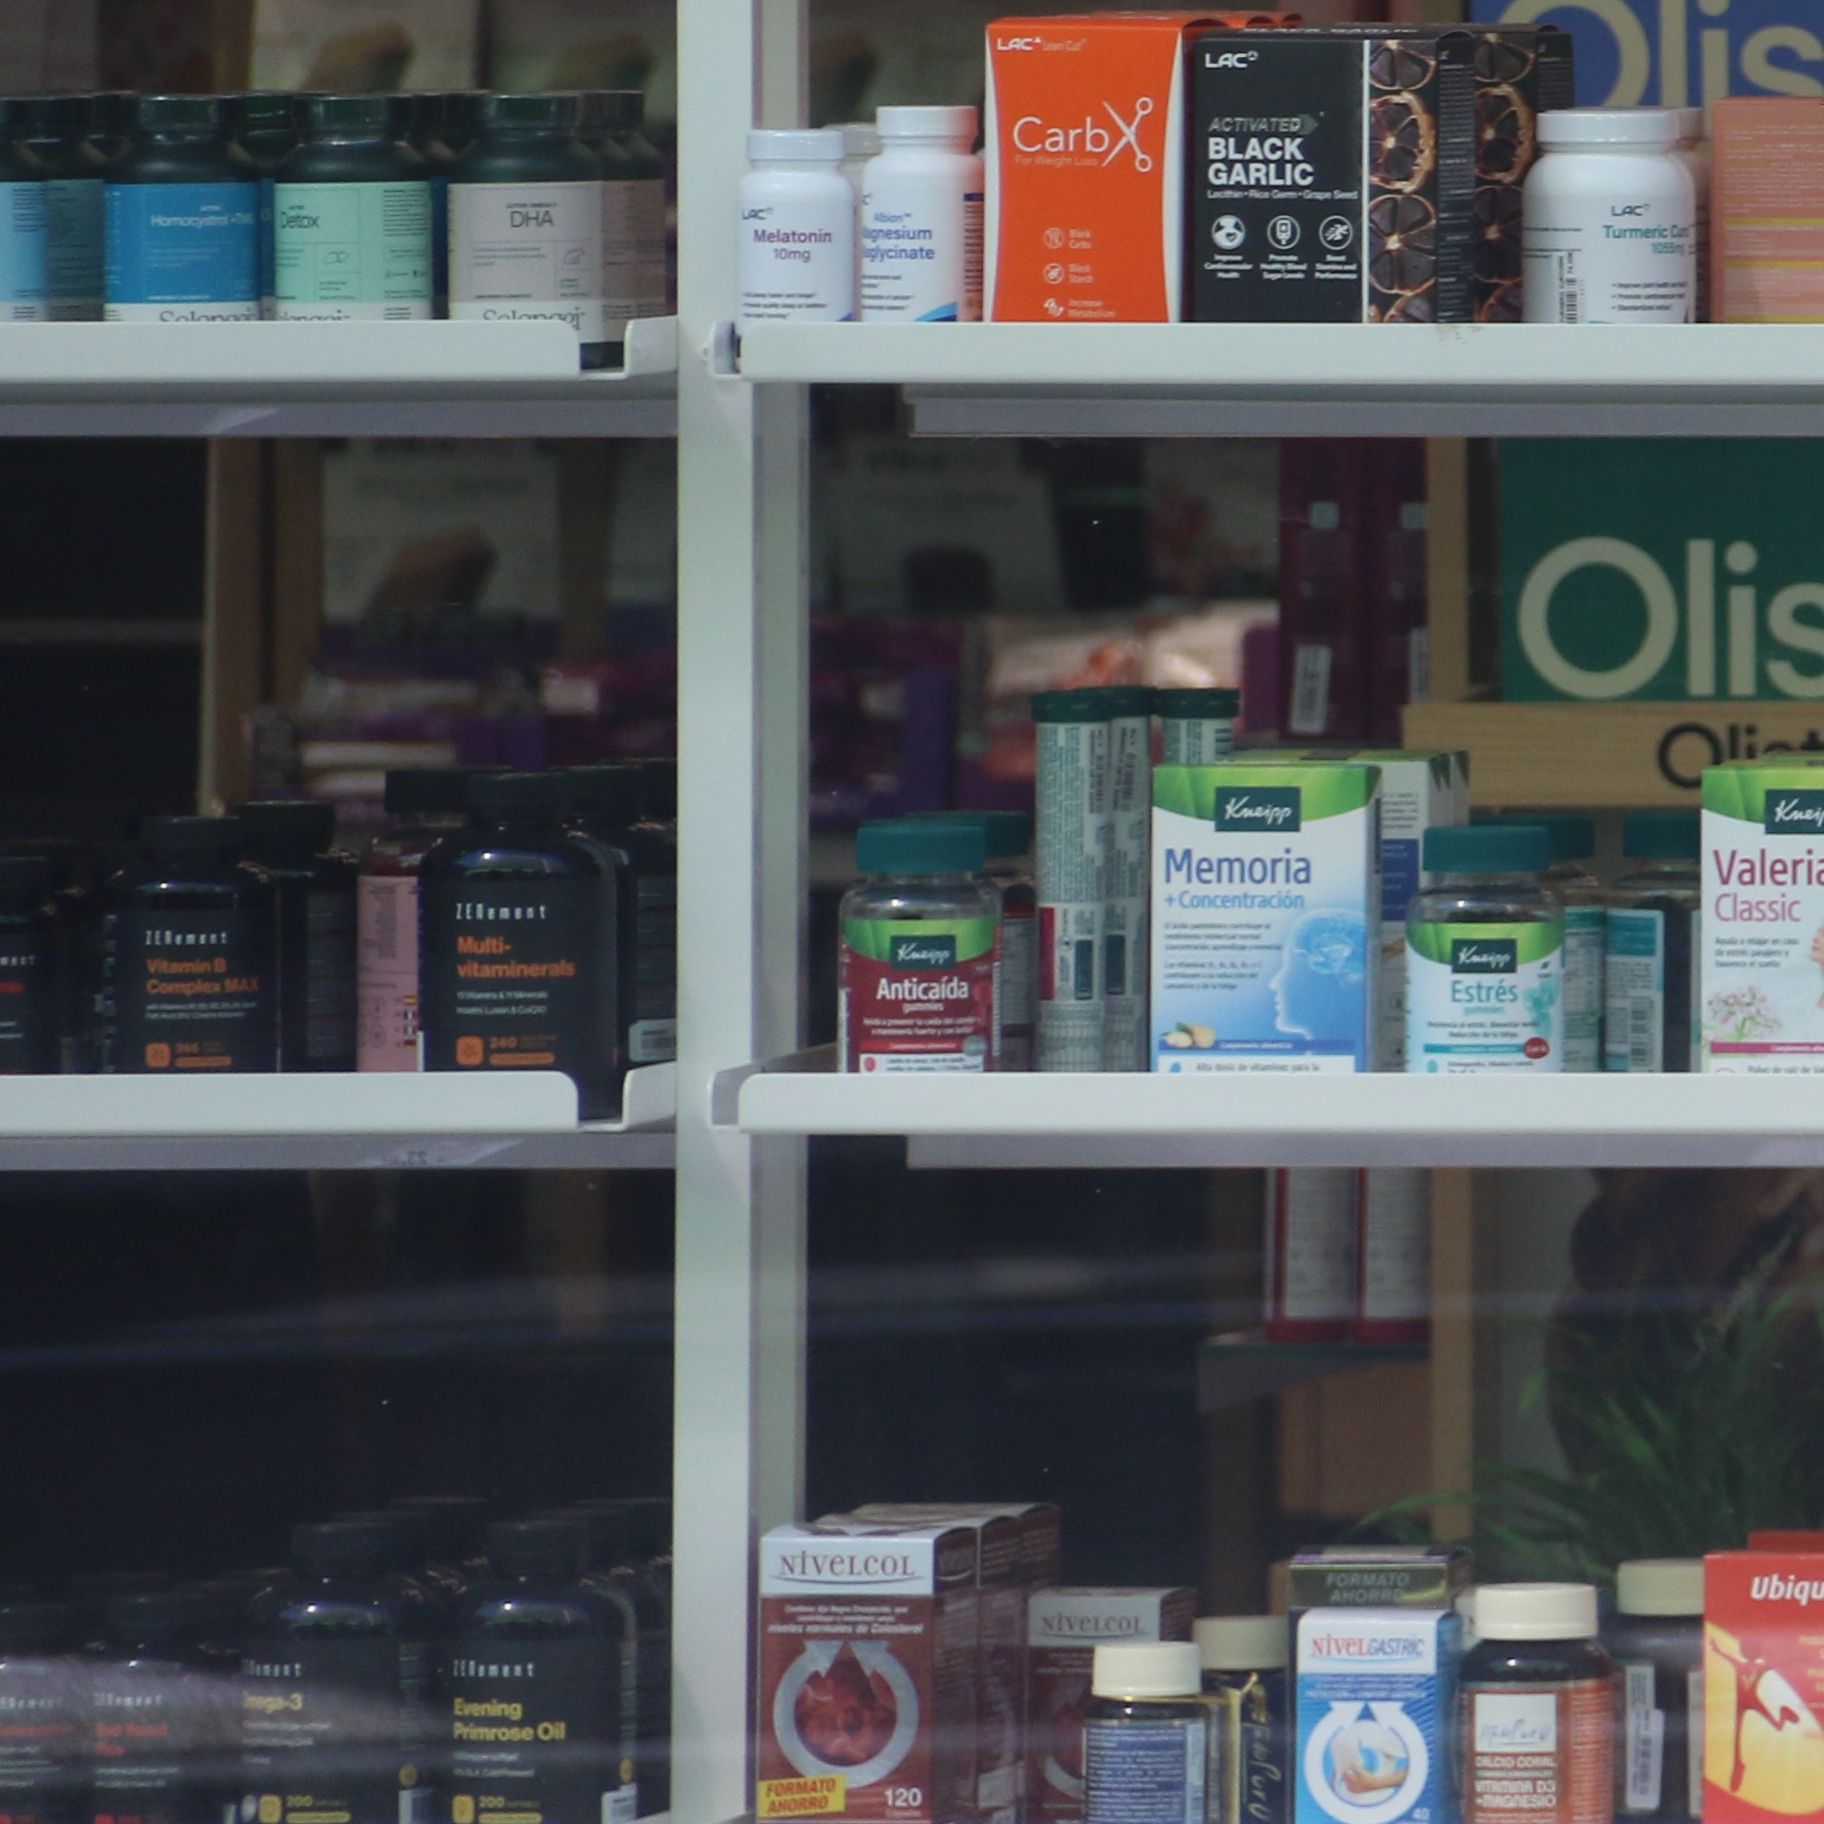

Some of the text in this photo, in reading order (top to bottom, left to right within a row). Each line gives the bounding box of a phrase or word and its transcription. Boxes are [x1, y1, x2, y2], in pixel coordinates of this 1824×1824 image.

[1208, 137, 1304, 160] BLACK
[1208, 163, 1314, 186] GARLIC
[509, 209, 555, 229] DHA
[753, 227, 833, 245] Melatonin
[864, 226, 933, 243] agnesium
[1603, 224, 1668, 240] Turmeric
[773, 247, 811, 262] 10mg
[1224, 797, 1293, 825] Kneipp
[1164, 848, 1312, 886] Memoria
[1714, 892, 1801, 922] Classic
[146, 958, 208, 974] Vitamin
[1457, 946, 1511, 966] Kneipp
[457, 959, 576, 979] vitaminerals
[146, 979, 220, 995] Complex
[876, 977, 969, 1002] Anticaída
[1451, 980, 1519, 1003] Estrés
[453, 1696, 523, 1721] Evening
[453, 1721, 566, 1744] Primrose Oil
[765, 1779, 836, 1797] FORMATO
[884, 1788, 922, 1807] 120
[768, 1795, 830, 1813] AHORRO
